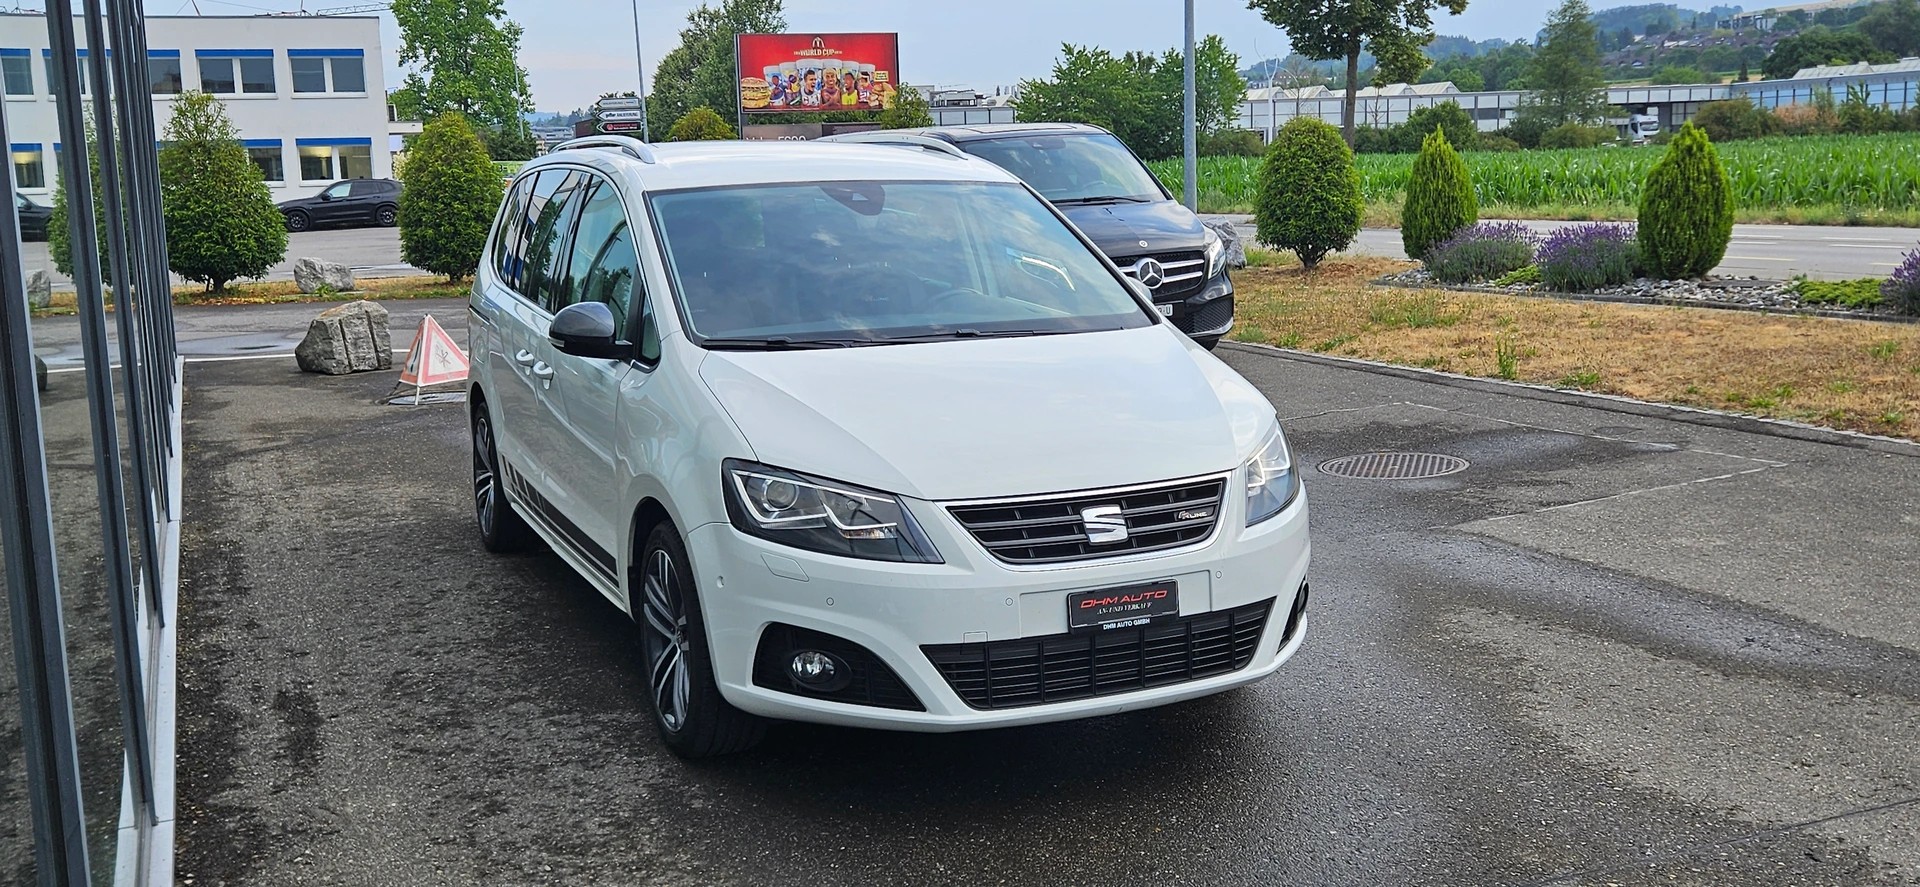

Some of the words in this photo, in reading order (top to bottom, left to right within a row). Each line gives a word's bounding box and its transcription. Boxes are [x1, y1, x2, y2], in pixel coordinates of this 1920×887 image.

[800, 48, 822, 56] WORLD
[822, 48, 835, 56] CUP
[1080, 597, 1119, 608] DHM
[1120, 590, 1168, 603] AUTO
[1117, 620, 1133, 629] AUTO
